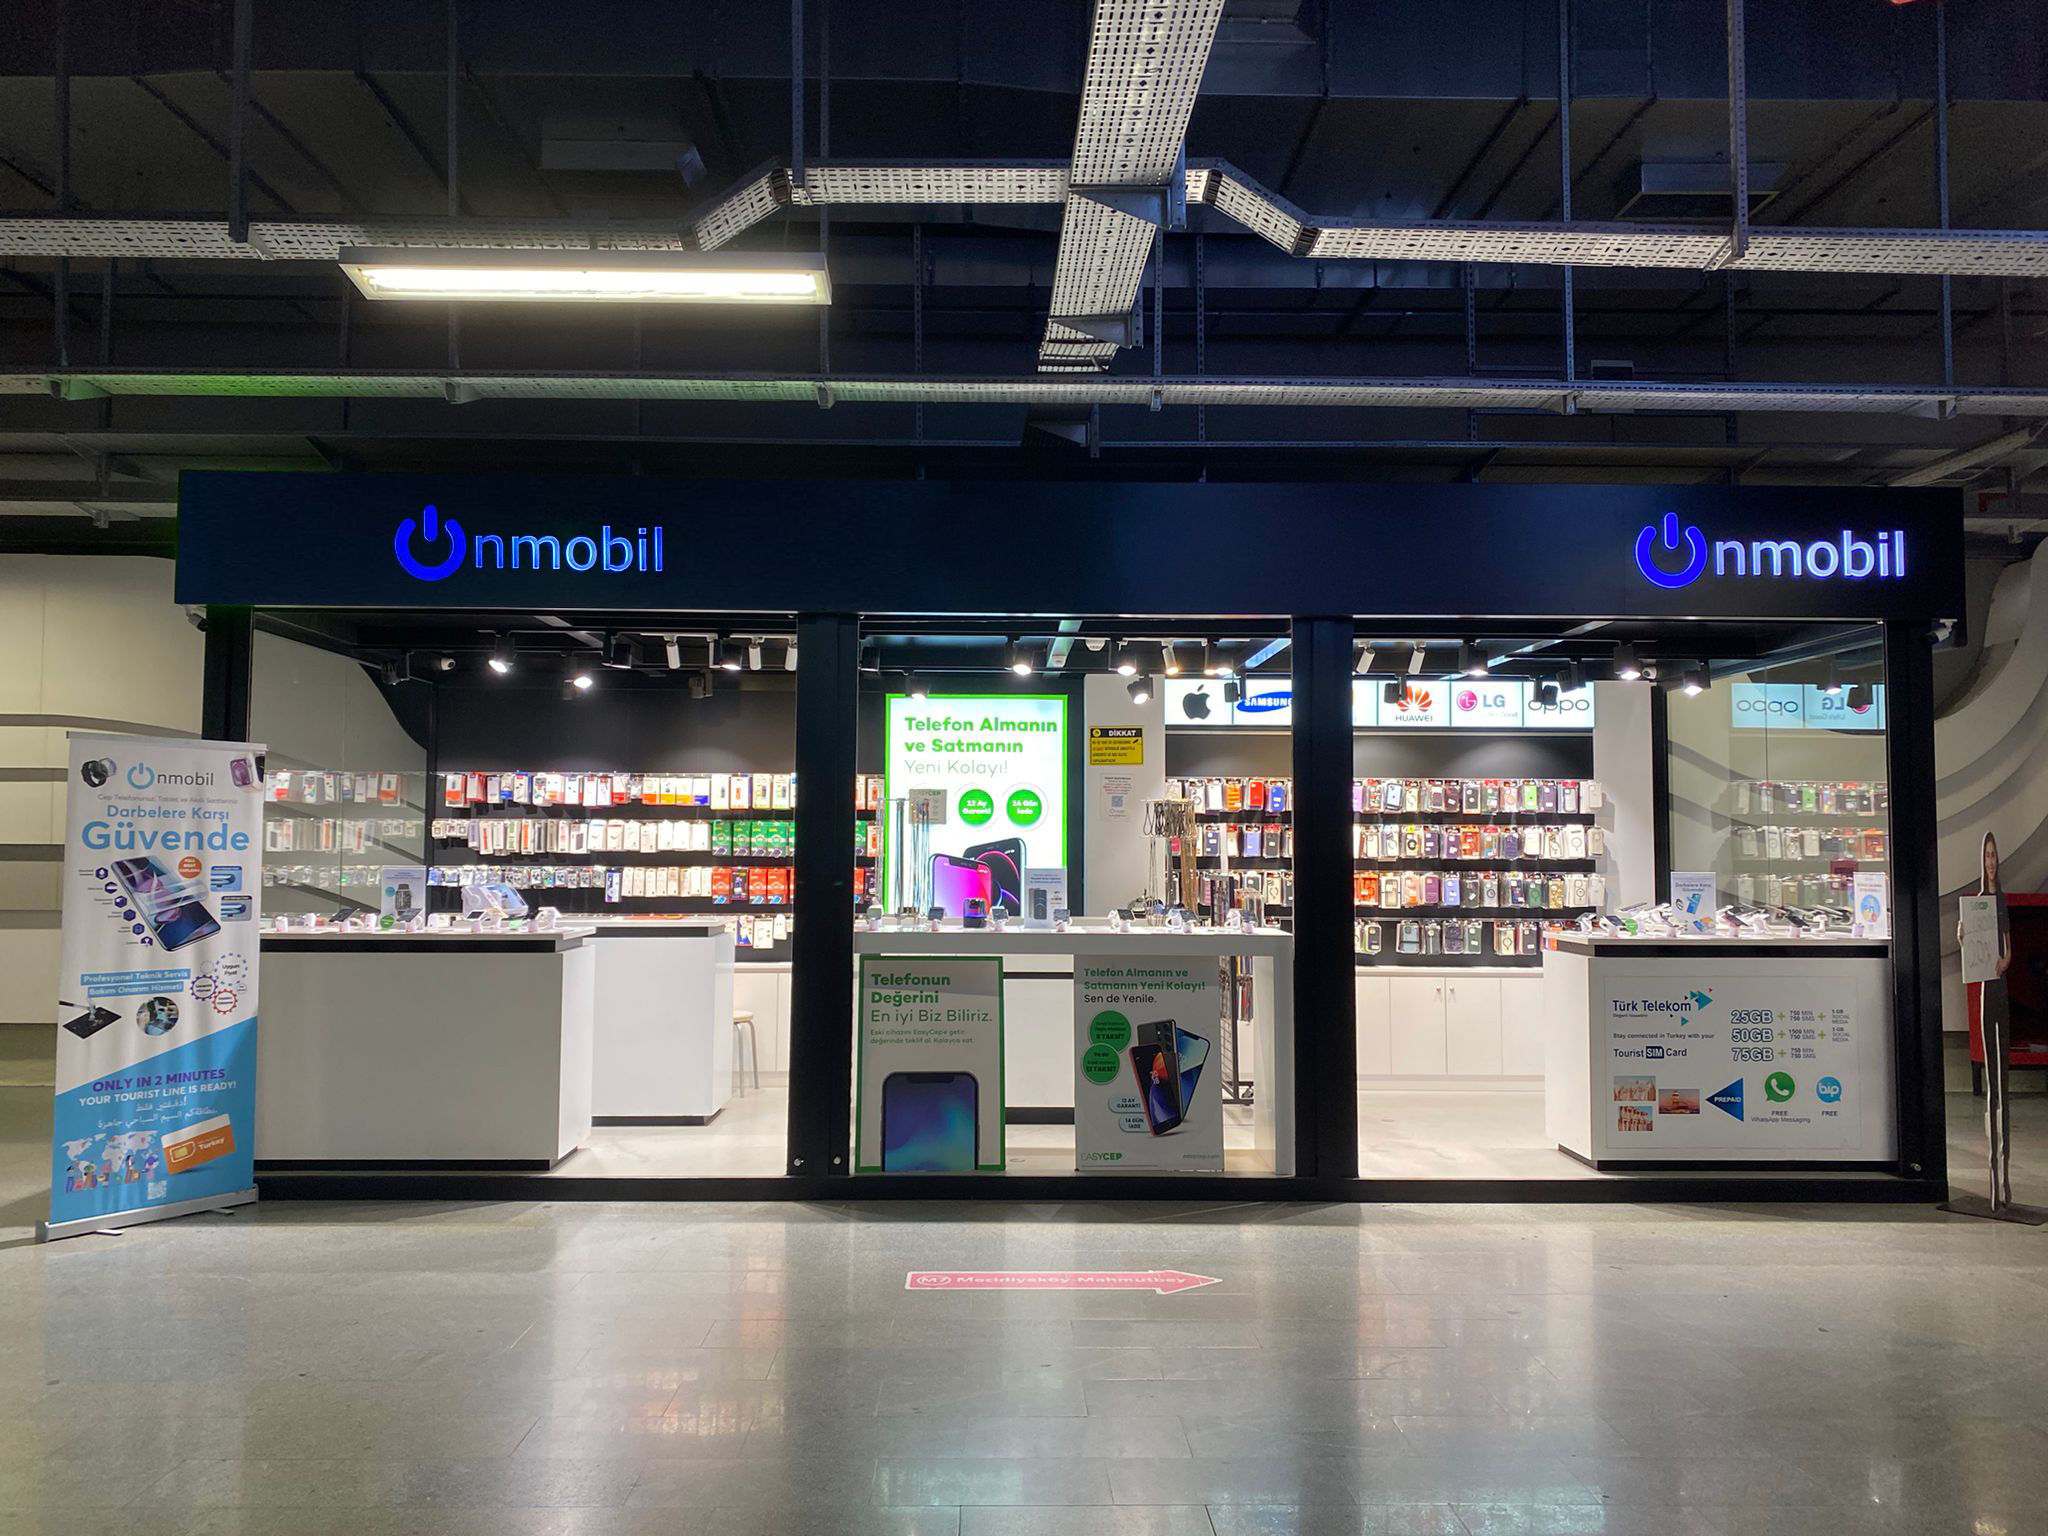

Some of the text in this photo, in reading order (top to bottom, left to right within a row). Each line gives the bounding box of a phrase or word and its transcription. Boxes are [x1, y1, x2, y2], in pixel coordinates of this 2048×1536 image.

[1483, 694, 1506, 708] LG
[905, 717, 1057, 732] Telefon Almanın
[1395, 714, 1433, 722] HUAWEI
[1108, 729, 1137, 737] DİKKAT
[905, 739, 1023, 753] ve Satmanın
[905, 760, 1008, 778] Yeni Kolayı!
[107, 805, 229, 823] Darbelere Karşı
[82, 821, 249, 850] Güvende
[871, 973, 950, 986] Telefonun
[1084, 968, 1124, 977] Telefon
[1126, 968, 1173, 977] Almanın
[1084, 981, 1206, 992] Satmanın Yeni Kolayı!
[871, 991, 939, 1007] Değerini
[1084, 994, 1157, 1003] Sen de Yenile.
[1612, 999, 1691, 1012] Türk Telekom
[871, 1010, 890, 1022] En
[919, 1010, 942, 1022] Biz
[947, 1009, 993, 1022] Biliriz.
[1730, 1009, 1773, 1024] 25GB
[1731, 1028, 1773, 1042] 50GB
[1613, 1047, 1687, 1057] Tourist SIM Card
[1731, 1047, 1774, 1061] 75GB
[93, 1068, 225, 1092] ONLY IN 2 MINUTES
[79, 1080, 237, 1107] YOUR TOURIST LINE IS READY!
[1819, 1083, 1840, 1098] bip
[199, 1137, 225, 1150] Turkey
